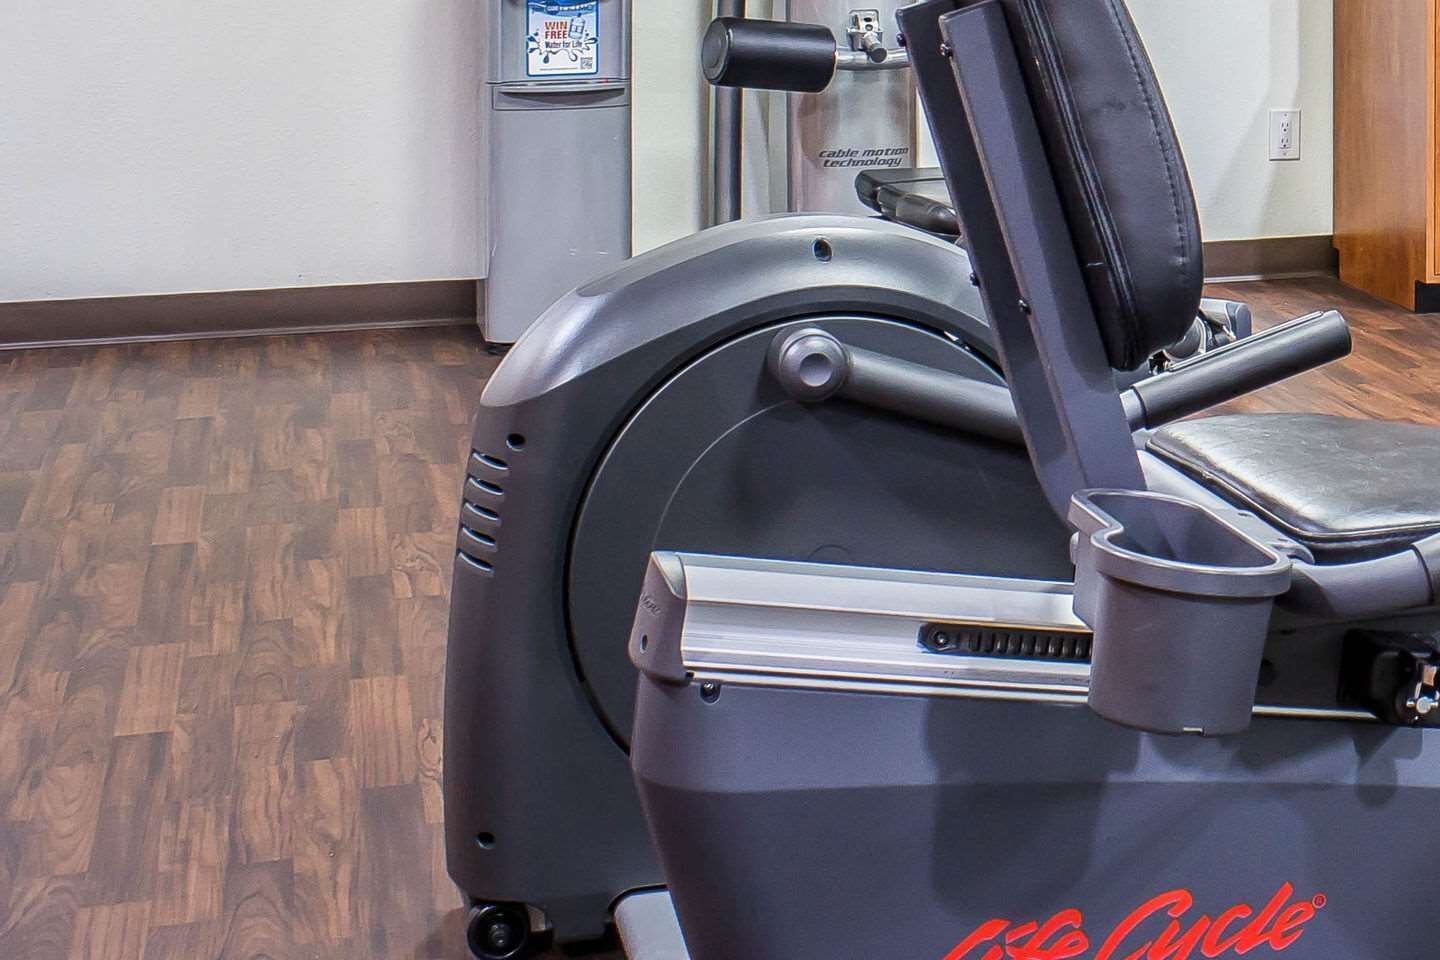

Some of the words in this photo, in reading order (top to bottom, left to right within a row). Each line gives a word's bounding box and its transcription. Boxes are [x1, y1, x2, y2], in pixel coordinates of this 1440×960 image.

[545, 21, 567, 30] WIN
[545, 31, 567, 39] FREE
[563, 40, 571, 48] for
[818, 148, 859, 158] cable
[862, 147, 909, 157] motion
[823, 157, 903, 168] technology
